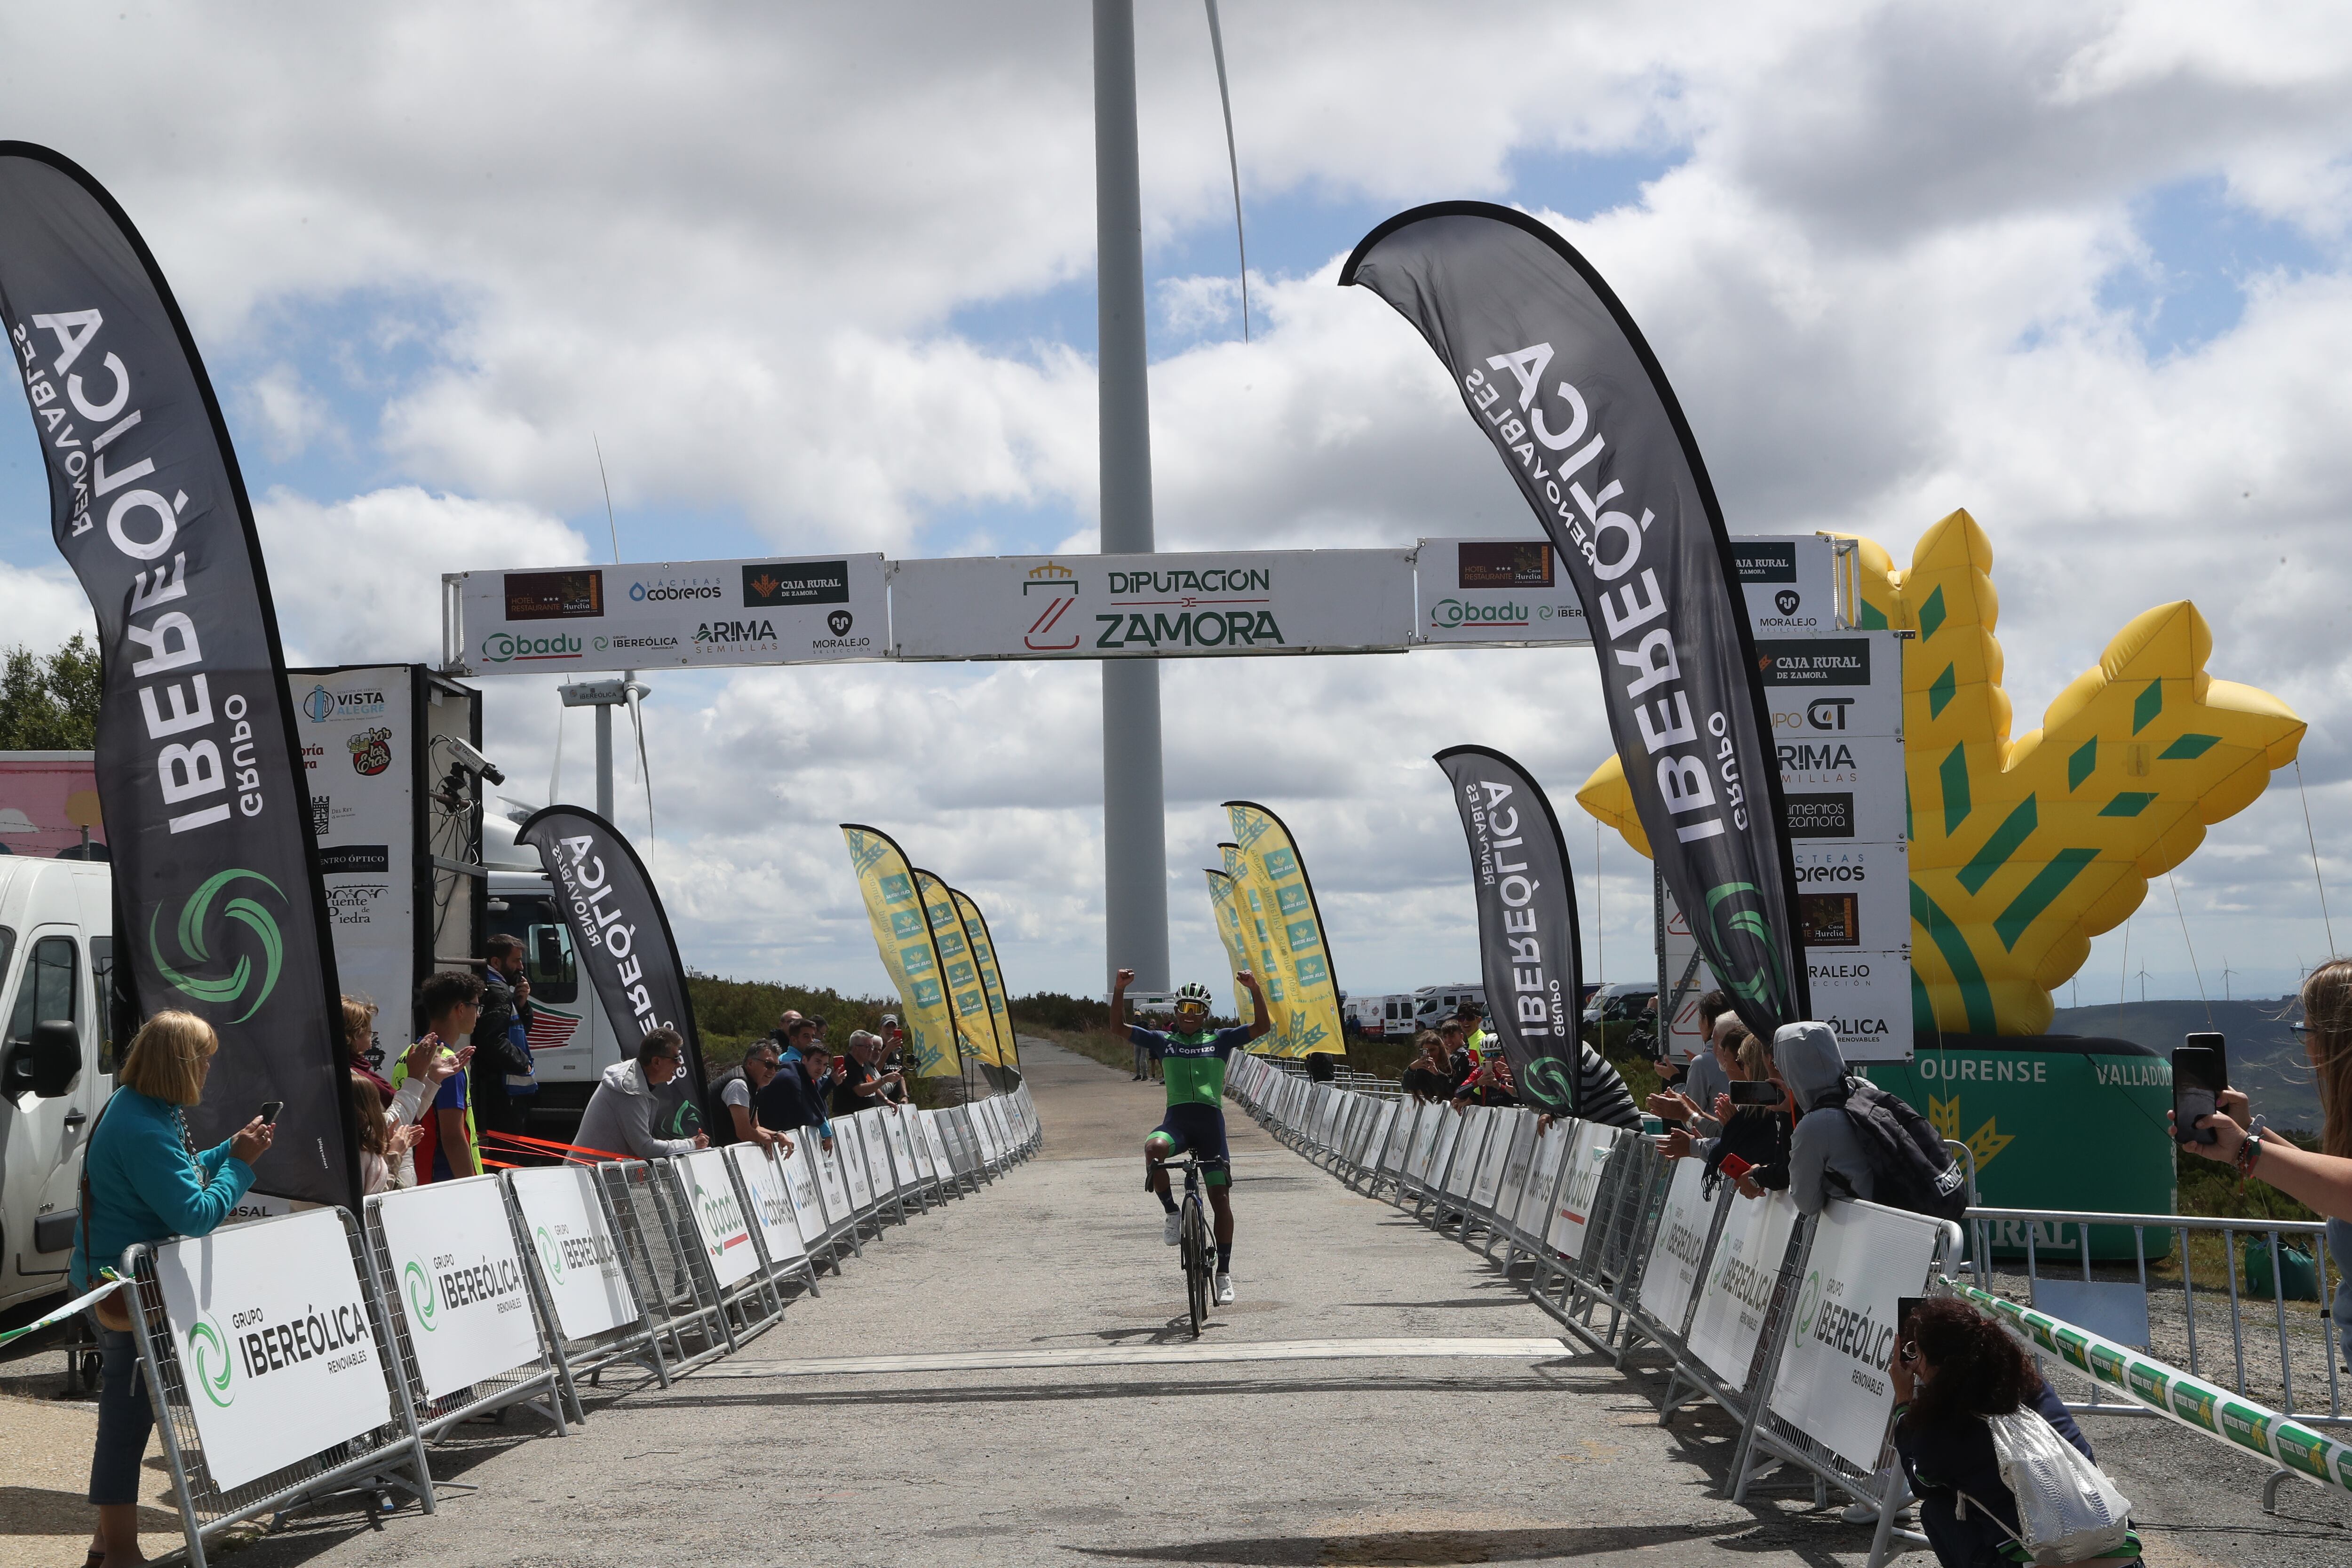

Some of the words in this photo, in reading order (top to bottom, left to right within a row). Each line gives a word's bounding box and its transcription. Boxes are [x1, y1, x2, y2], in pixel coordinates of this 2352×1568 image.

[1756, 559, 1788, 567] RURAL
[647, 578, 721, 587] LÁCTEAS
[781, 580, 805, 590] CAJA
[807, 579, 841, 589] RURAL
[647, 586, 721, 601] cobreros
[511, 603, 560, 612] RESTAURANTE
[1431, 598, 1528, 629] Cobadu
[1096, 611, 1285, 648] ZAMORA
[482, 633, 582, 662] Cobadu
[613, 636, 678, 648] IBEREÓLICA
[696, 643, 778, 653] SEMILLAS
[813, 637, 869, 648] MORALEJO
[1776, 657, 1810, 669] CAJA
[1813, 657, 1860, 668] RURAL
[337, 692, 384, 706] VISTA
[580, 691, 616, 700] IBEREÓLICA
[337, 704, 384, 715] ALEGRE
[370, 728, 390, 743] bar
[301, 743, 324, 756] oría
[304, 760, 317, 769] ra
[357, 753, 390, 773] Eras
[1782, 773, 1857, 783] MILLAS
[1788, 804, 1844, 815] imentos
[320, 856, 346, 865] ENTRO
[1796, 854, 1864, 863] CTEAS
[1809, 965, 1870, 978] RALEJO
[1825, 1016, 1889, 1035] ÓLICA
[1179, 1046, 1216, 1054] CORTIZO
[1920, 1059, 2046, 1082] OURENSE
[229, 1206, 272, 1217] OSAL
[695, 1183, 743, 1256] Cobadu
[554, 1224, 569, 1235] GRUPO
[1991, 1218, 2076, 1249] RAL
[560, 1230, 617, 1270] IBEREÓLICA
[1667, 1220, 1704, 1272] IBEREÓLICA
[433, 1253, 454, 1269] GRUPO
[438, 1255, 522, 1311] IBEREÓLICA
[1721, 1255, 1773, 1315] IBEREÓLICA
[1827, 1278, 1843, 1297] GRUPO
[497, 1297, 522, 1314] RENOVABLES
[232, 1307, 263, 1329] GRUPO
[239, 1303, 369, 1378] IBEREÓLICA
[327, 1350, 367, 1375] RENOVABLES
[1851, 1369, 1884, 1397] RENOVABLES
[2224, 1414, 2239, 1429] RURAL
[2239, 1421, 2250, 1434] CAJA
[2279, 1436, 2295, 1453] RURAL
[2296, 1444, 2308, 1458] CAJA
